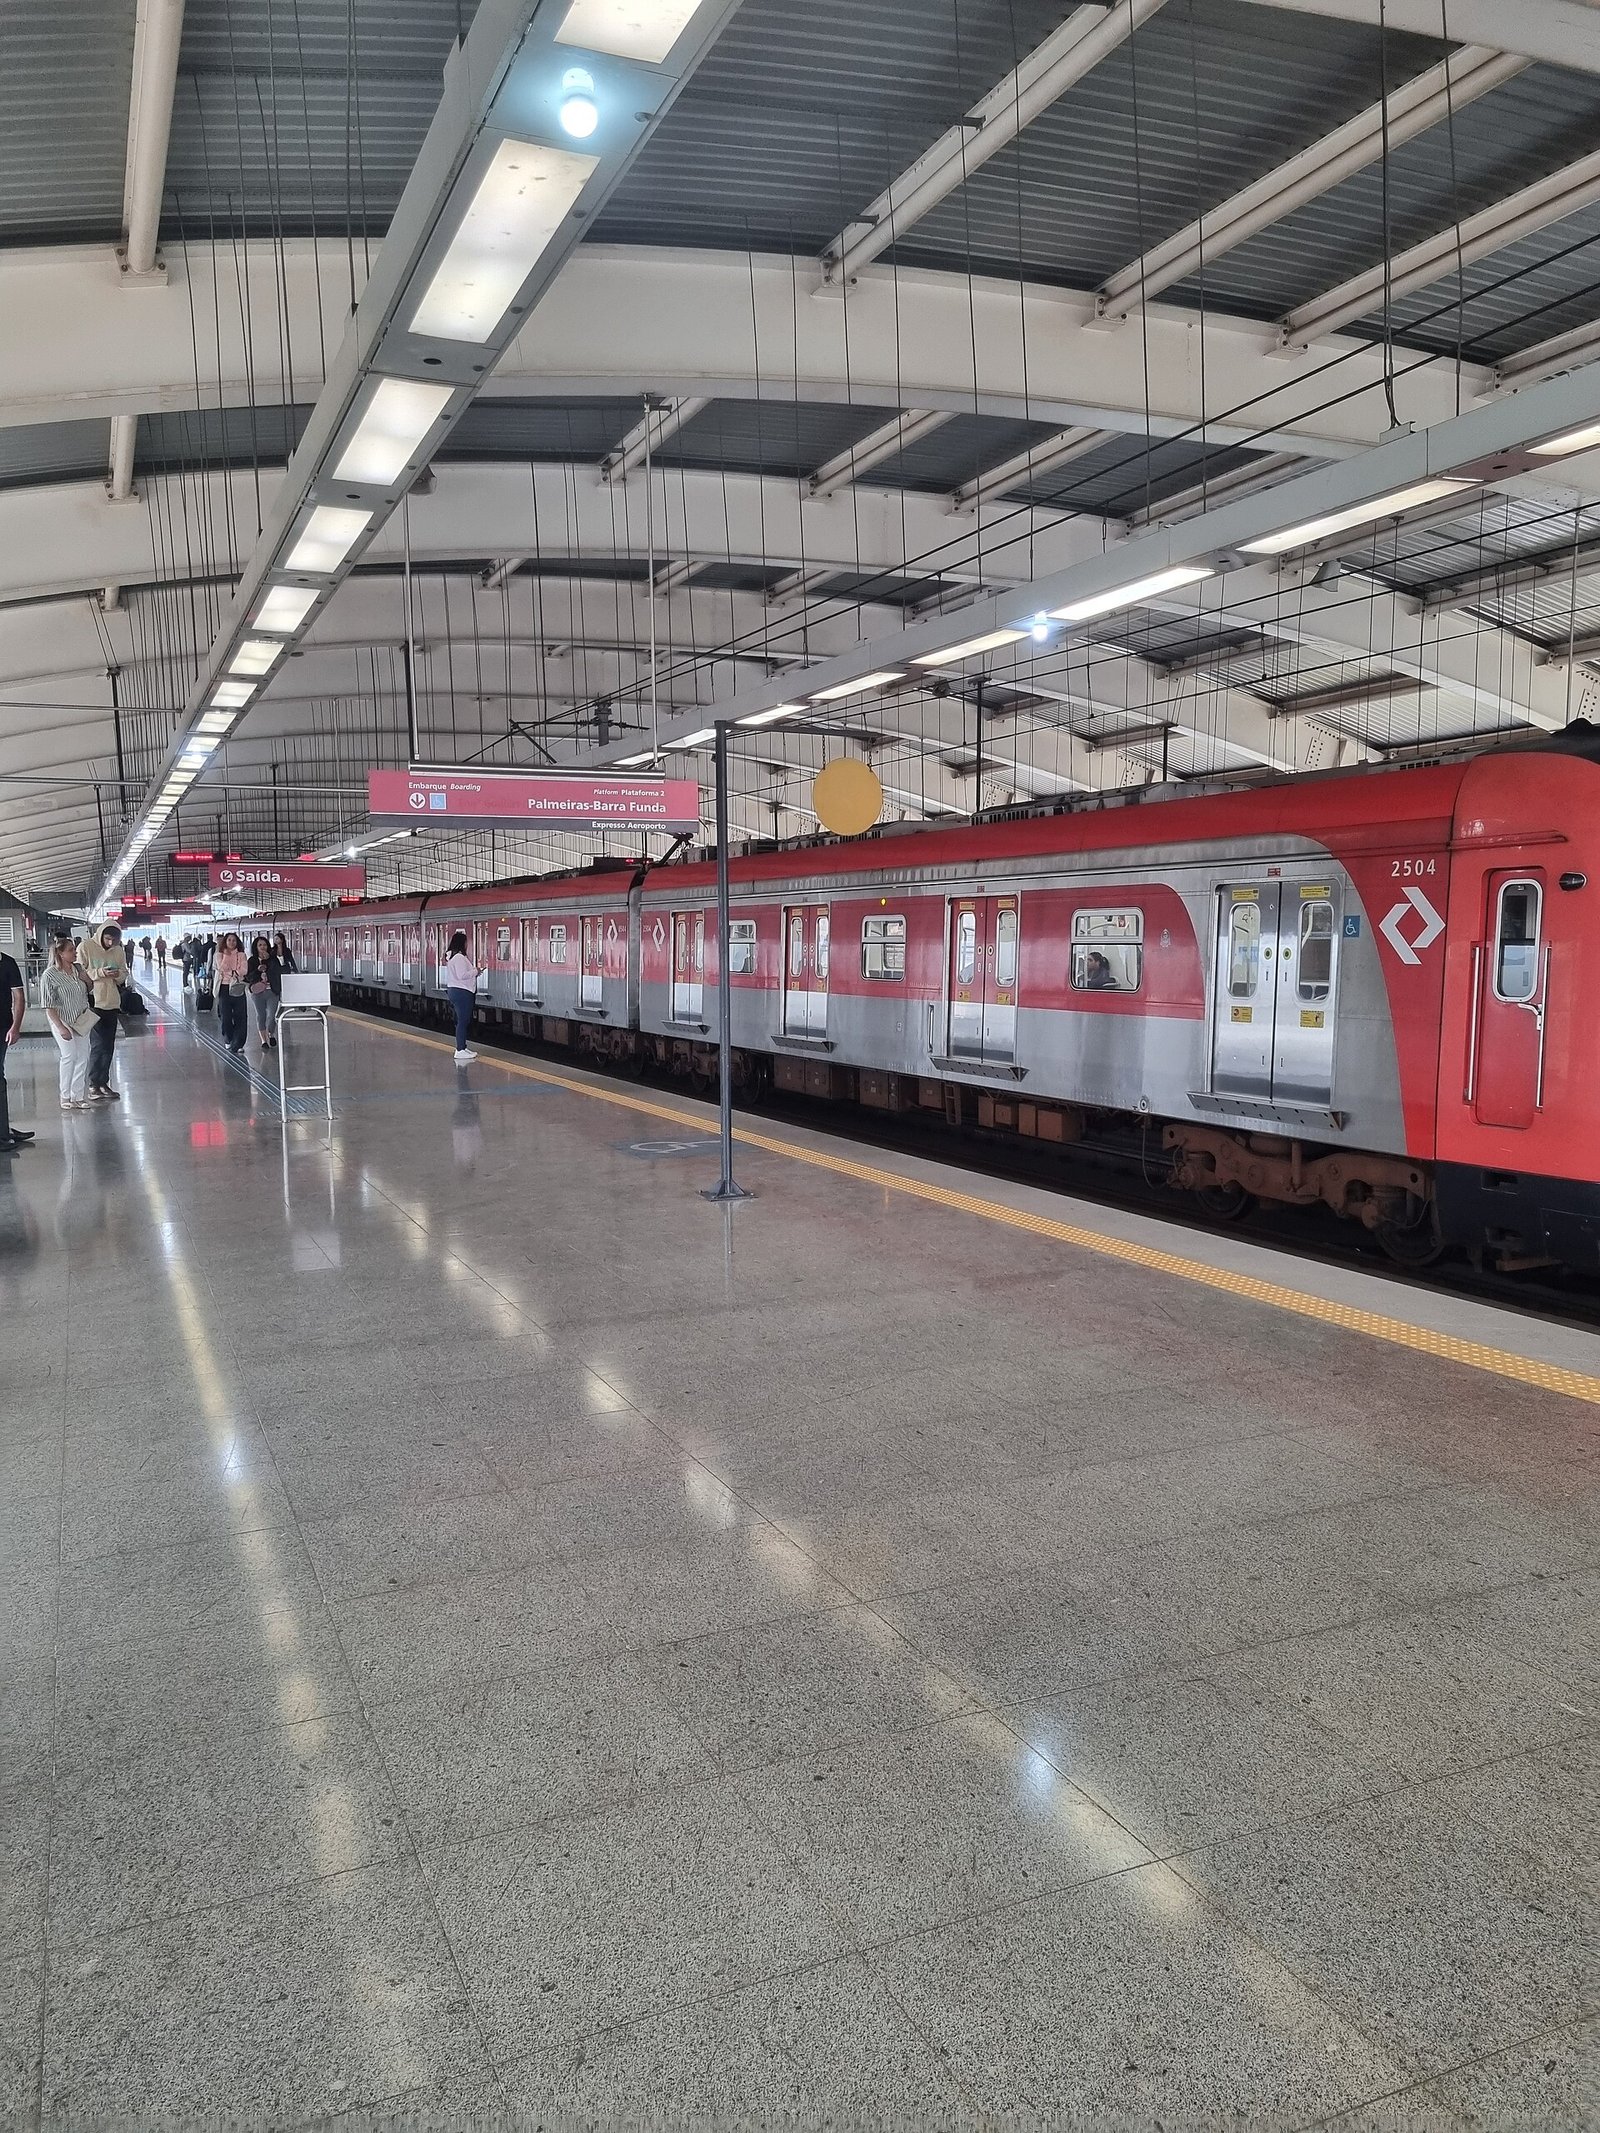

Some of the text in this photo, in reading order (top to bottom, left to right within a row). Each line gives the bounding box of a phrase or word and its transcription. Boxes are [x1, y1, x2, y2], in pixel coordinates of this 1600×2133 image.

[408, 782, 481, 792] Embarque Boarding
[621, 789, 659, 797] Plataforma
[528, 799, 626, 812] Palmeiras-Barra
[629, 802, 666, 813] Funda
[591, 821, 667, 831] Expresso Aeroporto
[1391, 858, 1436, 877] 2504
[235, 869, 281, 883] Saída
